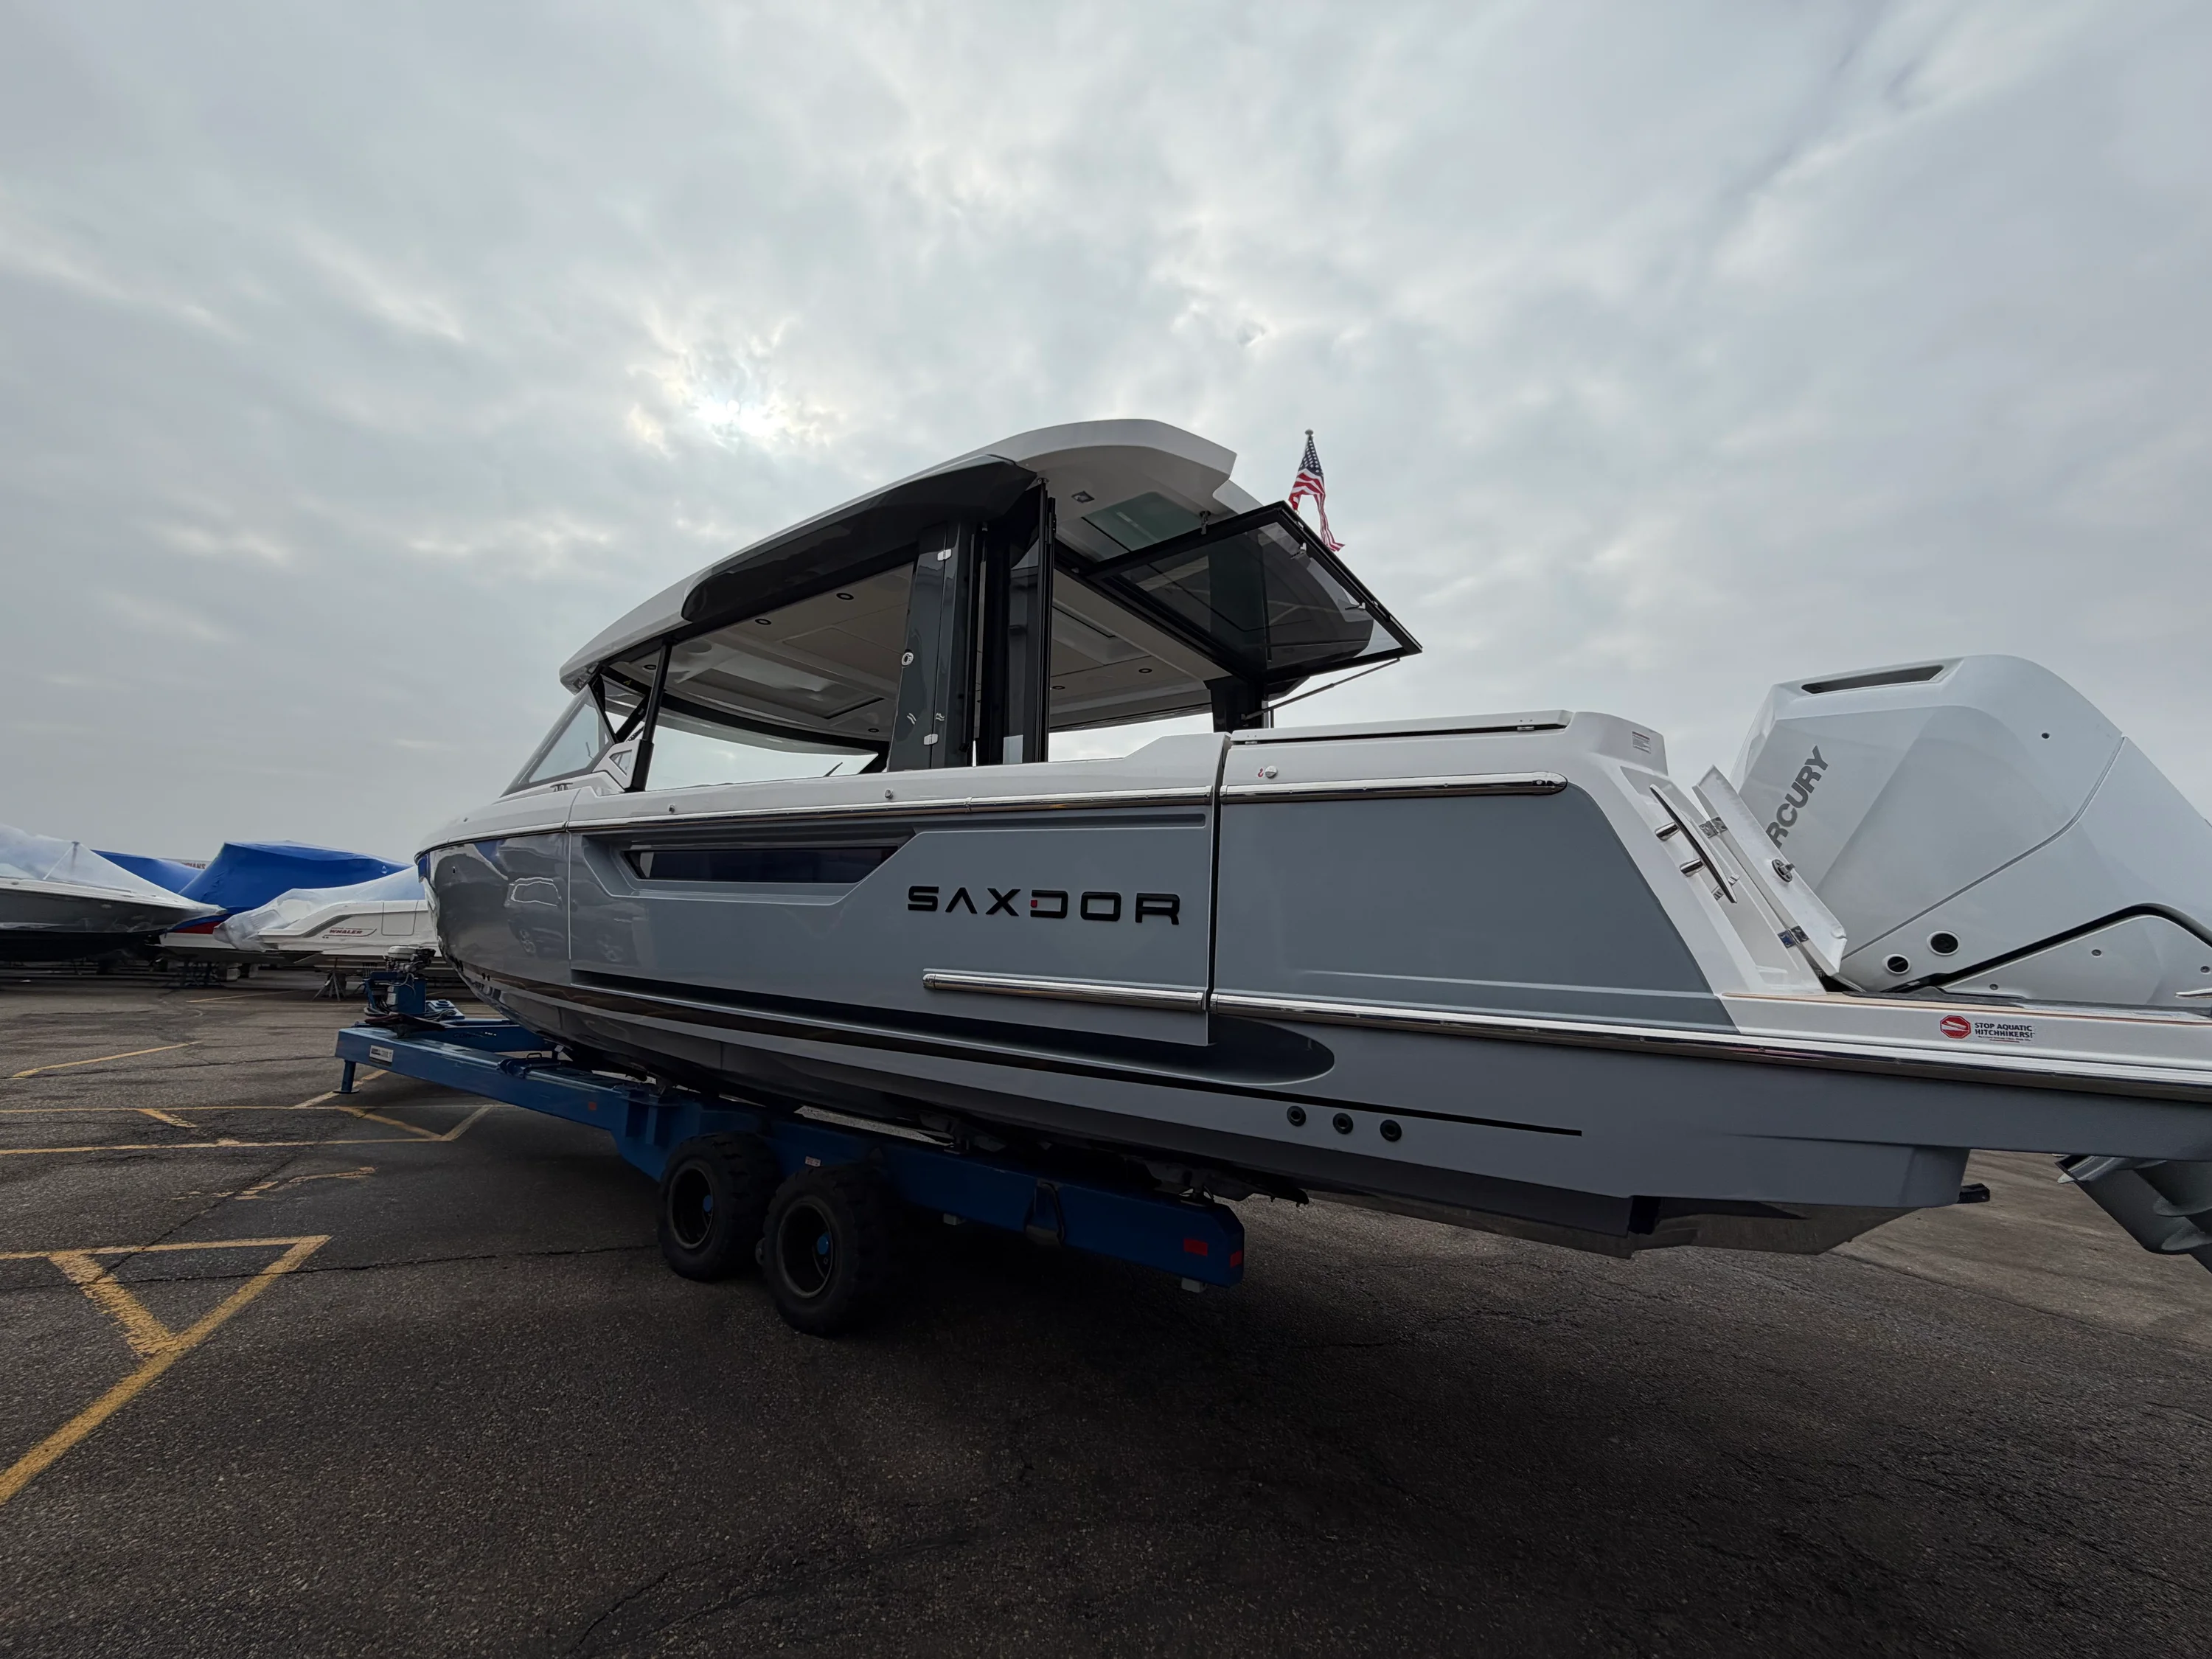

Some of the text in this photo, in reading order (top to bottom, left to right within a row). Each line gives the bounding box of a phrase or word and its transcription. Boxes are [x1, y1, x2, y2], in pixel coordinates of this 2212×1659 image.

[1766, 745, 1829, 849] RCURY
[908, 886, 1180, 925] SAXDOR
[1975, 1029, 2034, 1038] HITCHHIKERS!
[1997, 1023, 2033, 1032] AQUATIC
